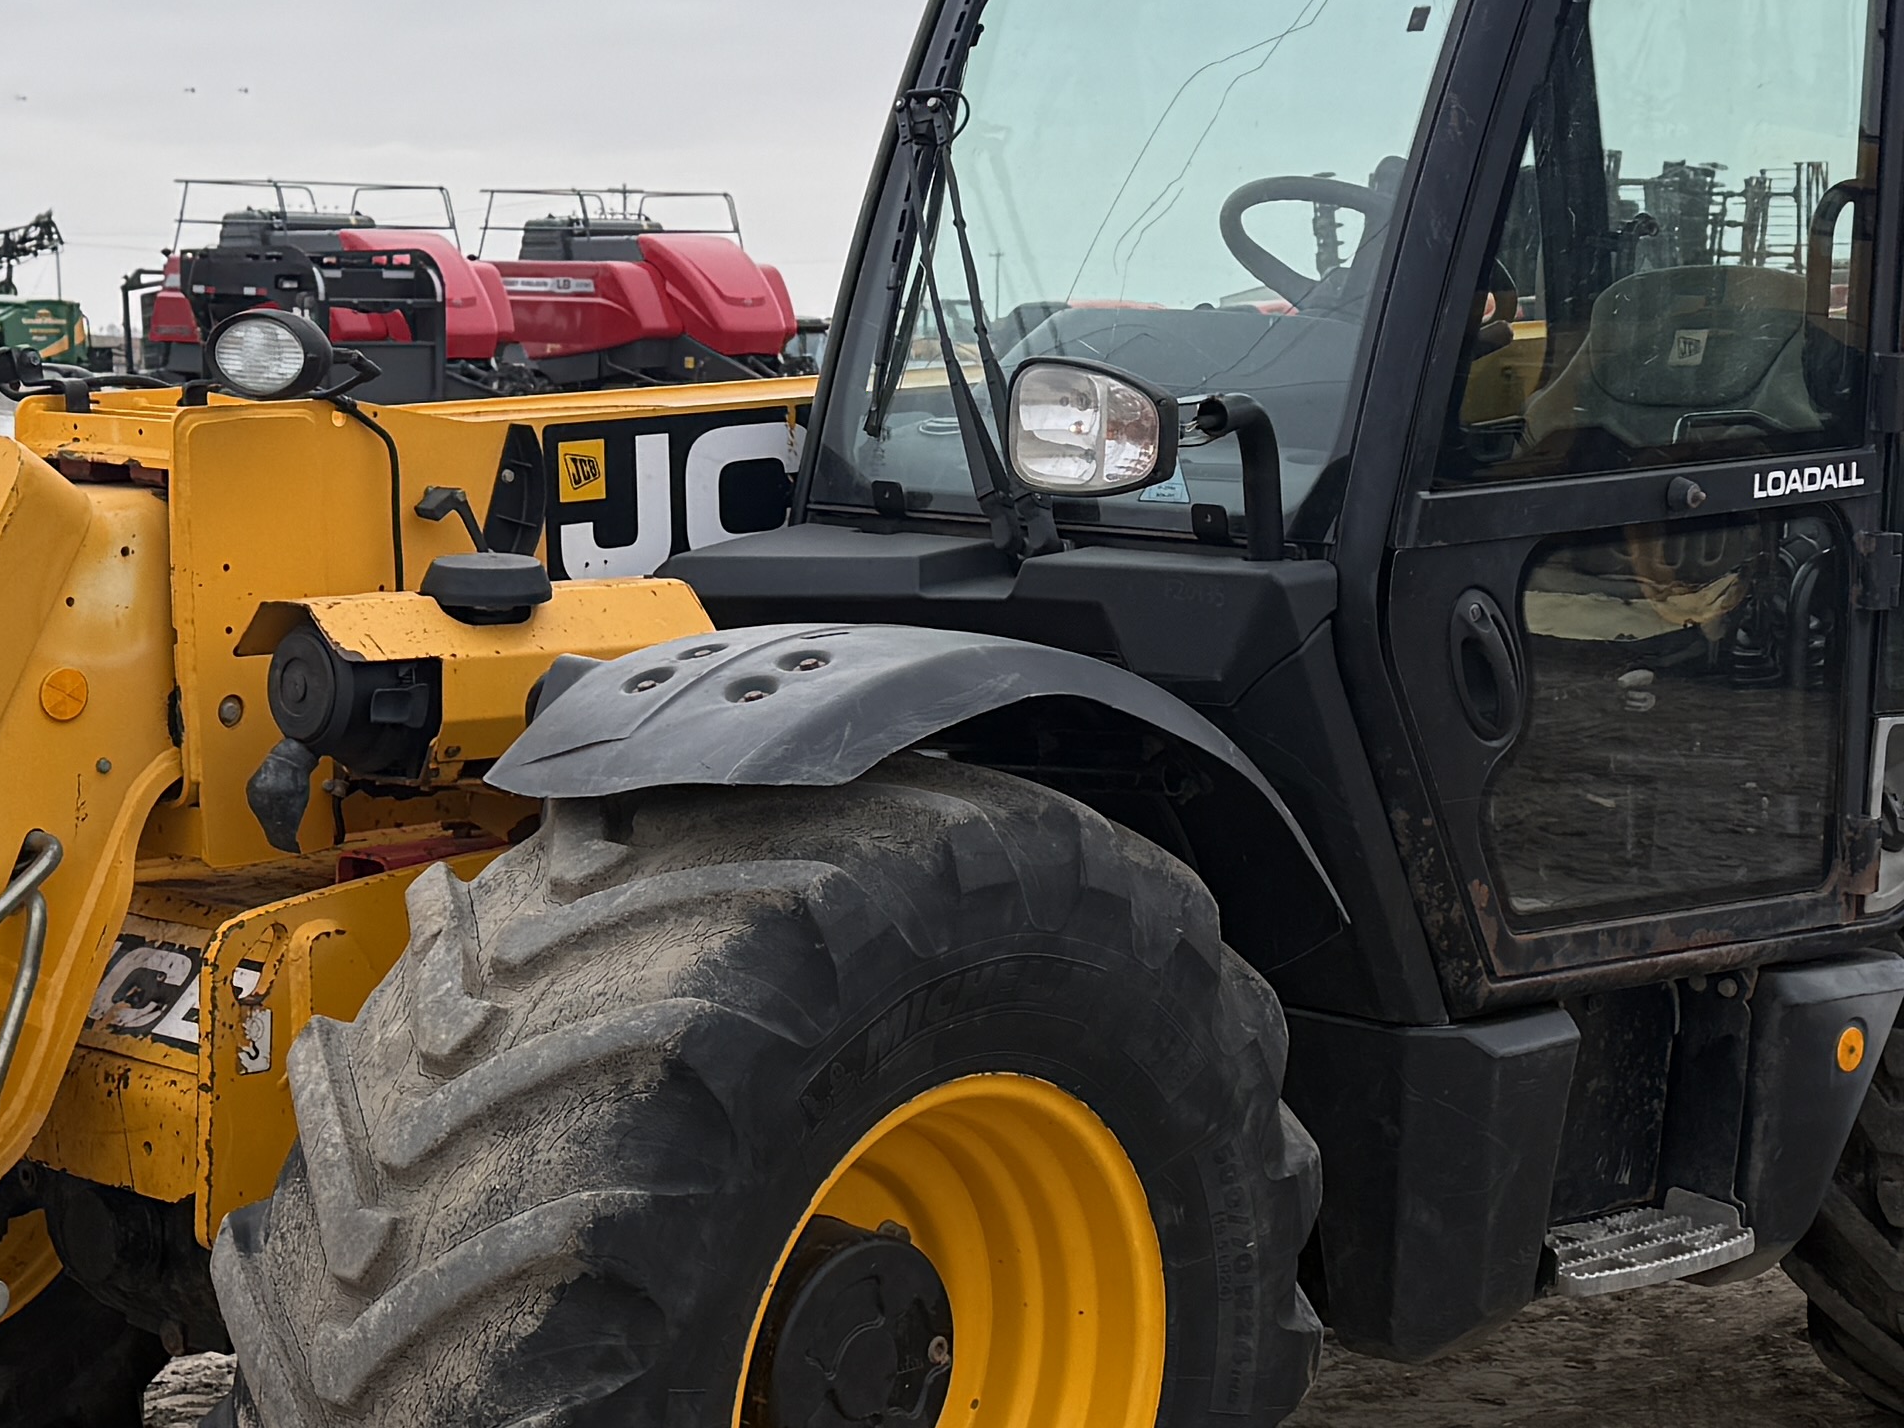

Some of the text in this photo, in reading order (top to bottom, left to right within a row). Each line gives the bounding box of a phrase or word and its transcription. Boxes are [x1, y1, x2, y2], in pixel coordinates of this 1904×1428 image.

[569, 456, 598, 487] JCB
[1753, 461, 1865, 499] LOADALL
[561, 422, 807, 580] JC
